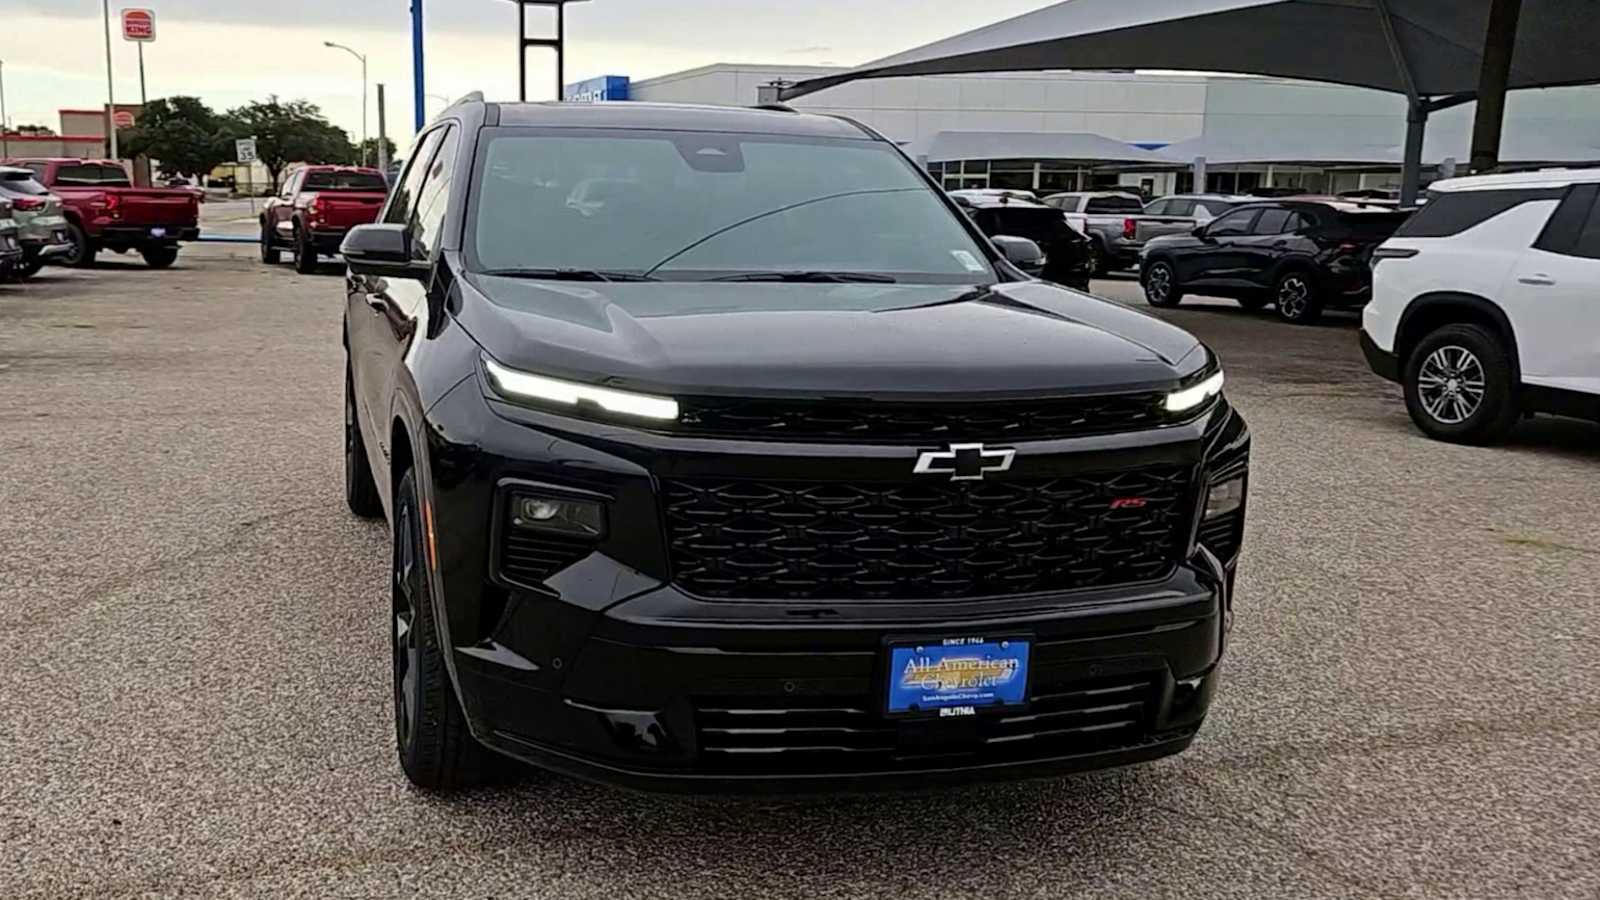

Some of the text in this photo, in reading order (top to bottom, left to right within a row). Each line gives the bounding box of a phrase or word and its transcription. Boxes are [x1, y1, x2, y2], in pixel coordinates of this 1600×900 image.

[1110, 498, 1147, 509] RS
[904, 655, 1019, 673] All American
[921, 671, 997, 690] Chevrolet
